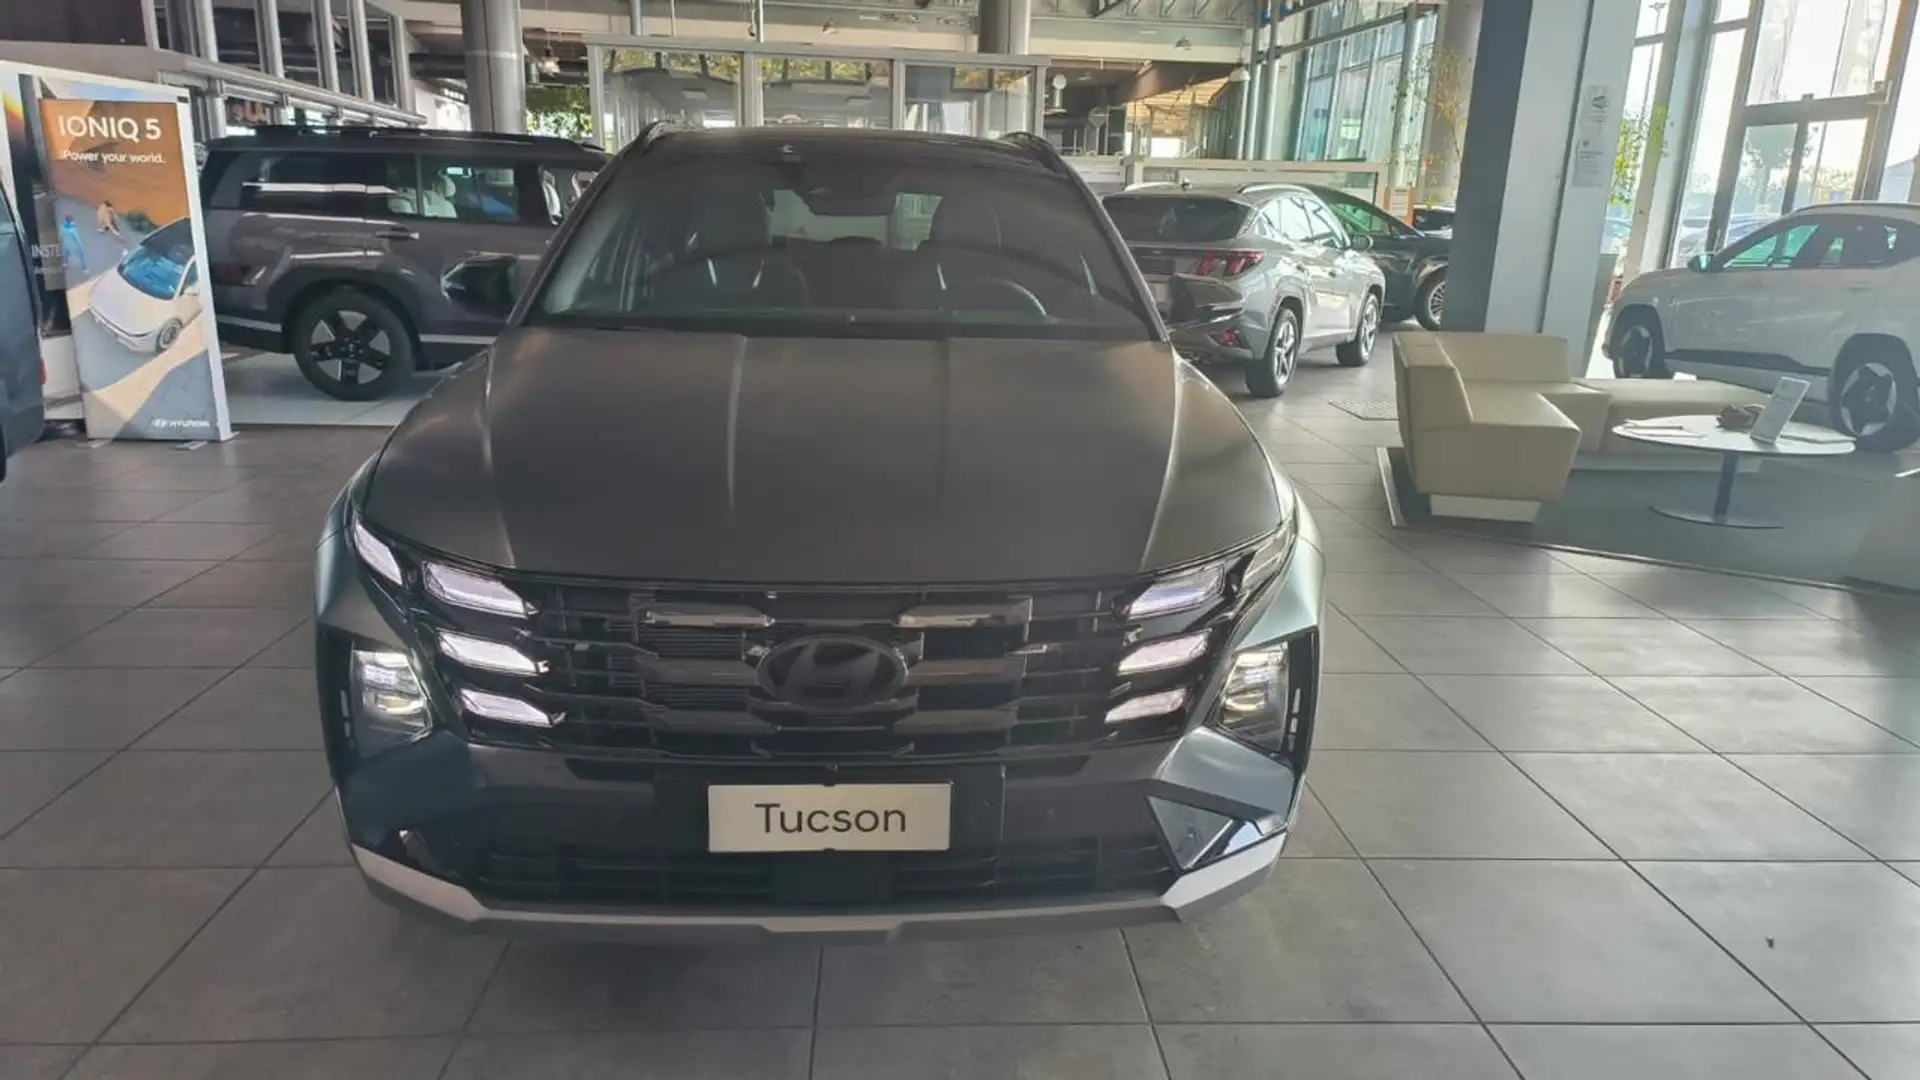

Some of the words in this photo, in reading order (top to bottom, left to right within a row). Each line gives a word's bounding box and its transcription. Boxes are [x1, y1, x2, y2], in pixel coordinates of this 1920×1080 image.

[58, 115, 140, 143] IONIQ
[145, 118, 162, 140] 5
[63, 149, 99, 161] Power
[101, 151, 126, 164] your
[31, 245, 61, 257] INSTE
[755, 803, 906, 833] Tucson
